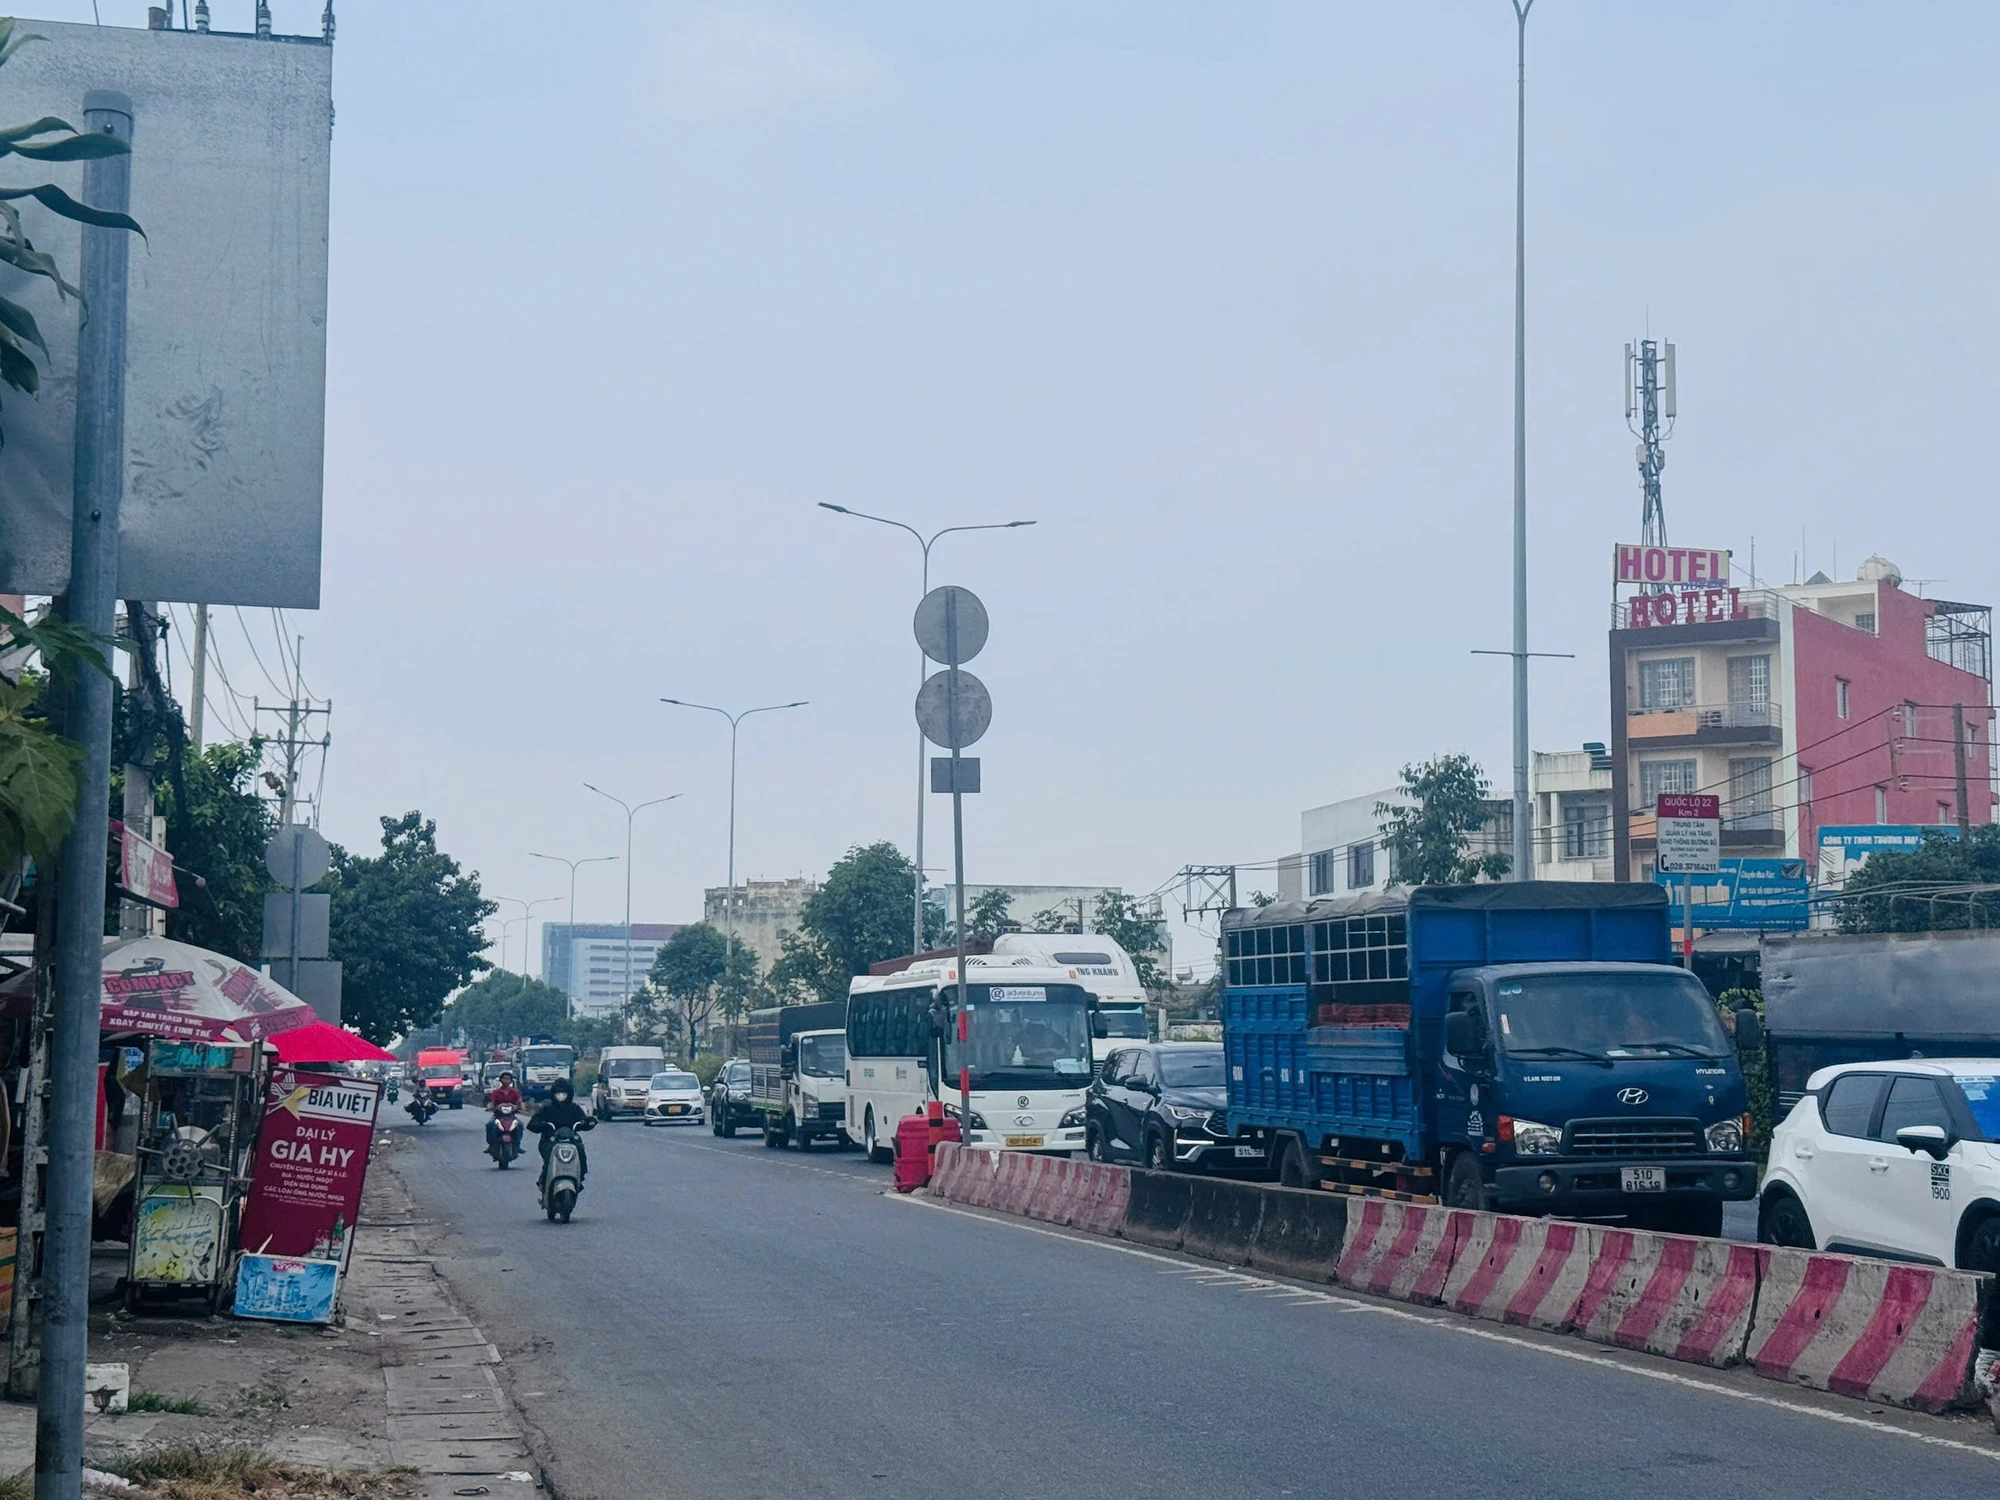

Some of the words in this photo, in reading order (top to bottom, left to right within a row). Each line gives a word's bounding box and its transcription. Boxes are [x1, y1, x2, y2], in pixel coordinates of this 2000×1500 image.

[1620, 547, 1726, 582] HOTEL
[1629, 588, 1749, 627] HOTEL
[1702, 798, 1712, 807] 22
[1843, 836, 1852, 845] TY
[104, 971, 196, 994] COMPACT
[308, 1089, 334, 1109] BIA
[335, 1092, 371, 1114] VIỆT
[296, 1126, 318, 1141] ĐẠI
[321, 1128, 336, 1141] LÝ
[271, 1139, 312, 1163] GIA
[319, 1146, 355, 1168] HY
[269, 1162, 295, 1171] CHUYÊN
[1931, 1163, 1949, 1176] SKC
[1931, 1186, 1950, 1200] 1900
